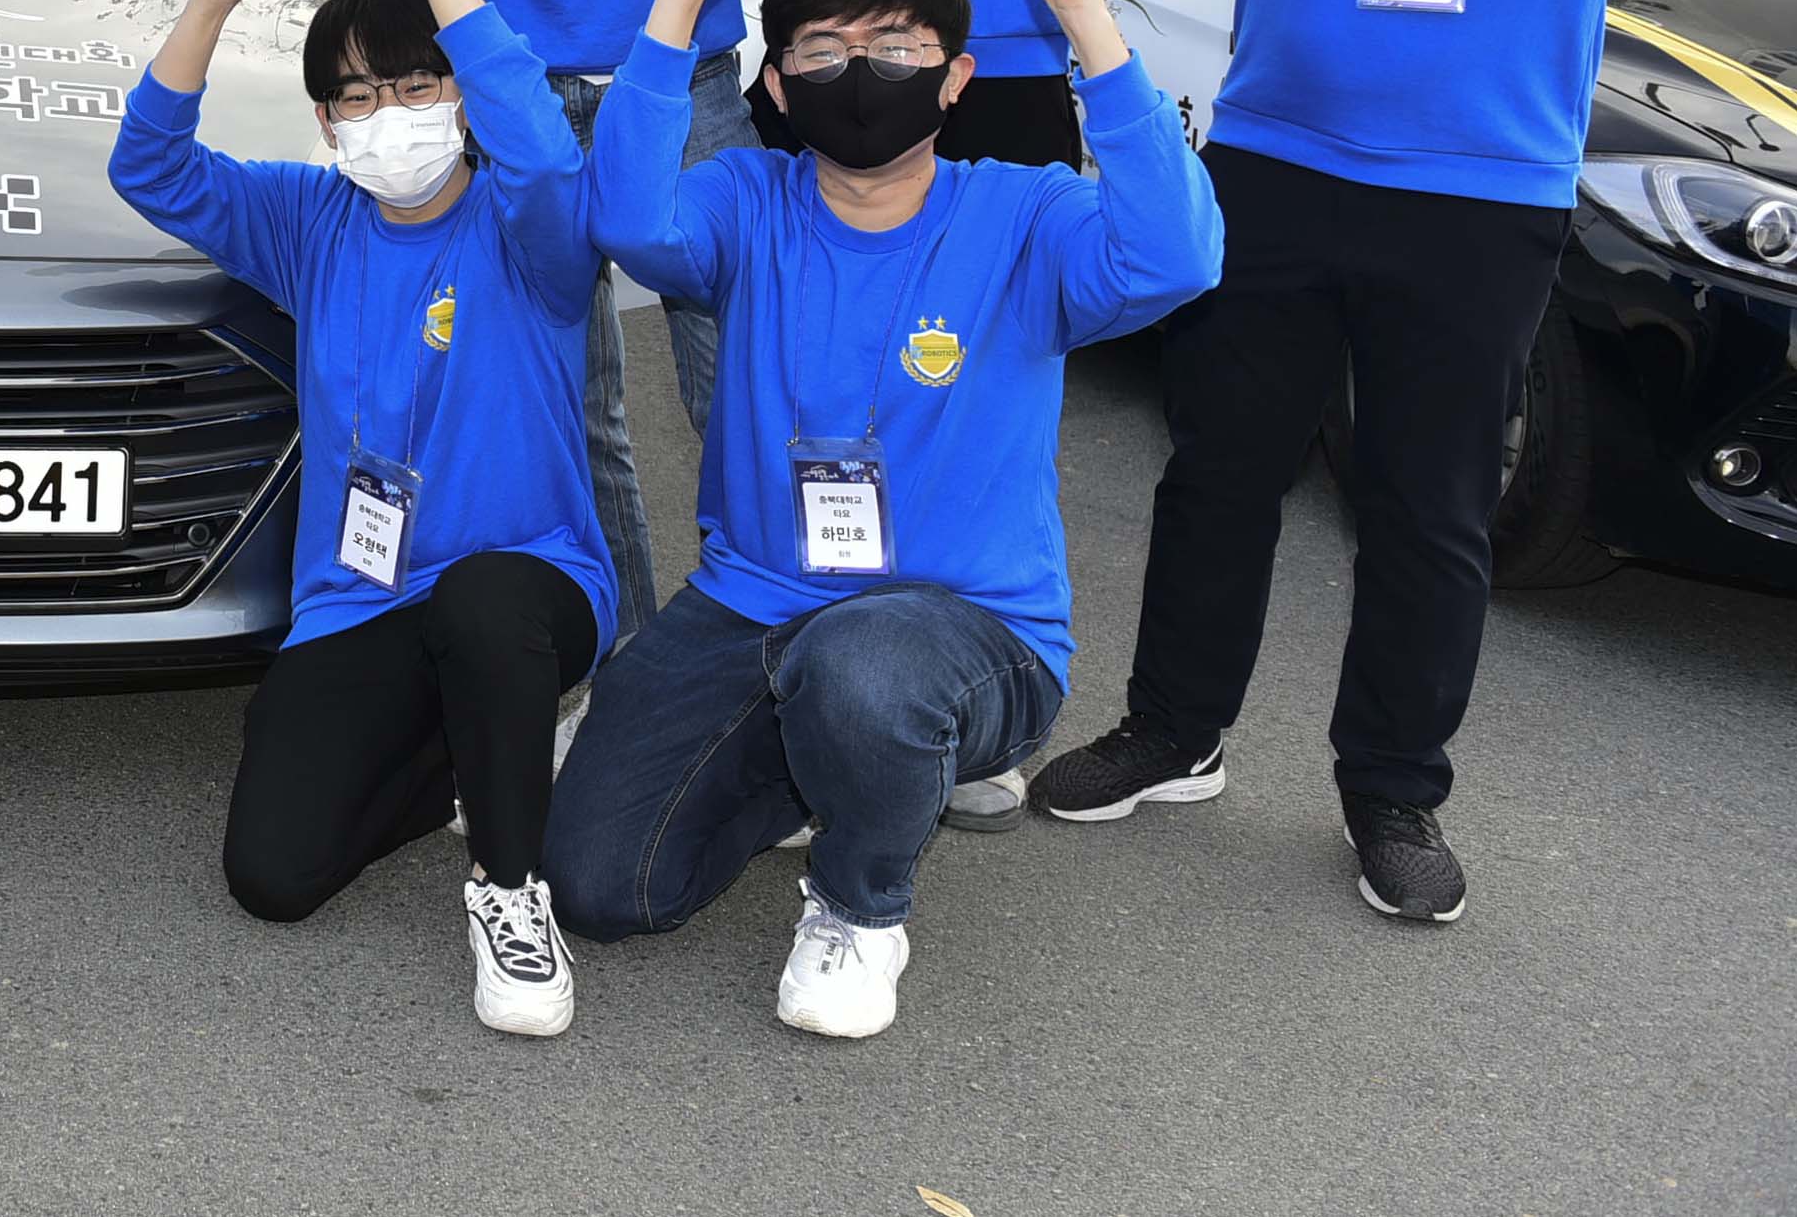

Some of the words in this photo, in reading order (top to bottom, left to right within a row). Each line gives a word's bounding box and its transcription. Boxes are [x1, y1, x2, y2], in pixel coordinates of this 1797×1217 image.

[819, 495, 863, 505] 충북대학교
[833, 509, 851, 518] 타요
[821, 526, 867, 542] 하민호
